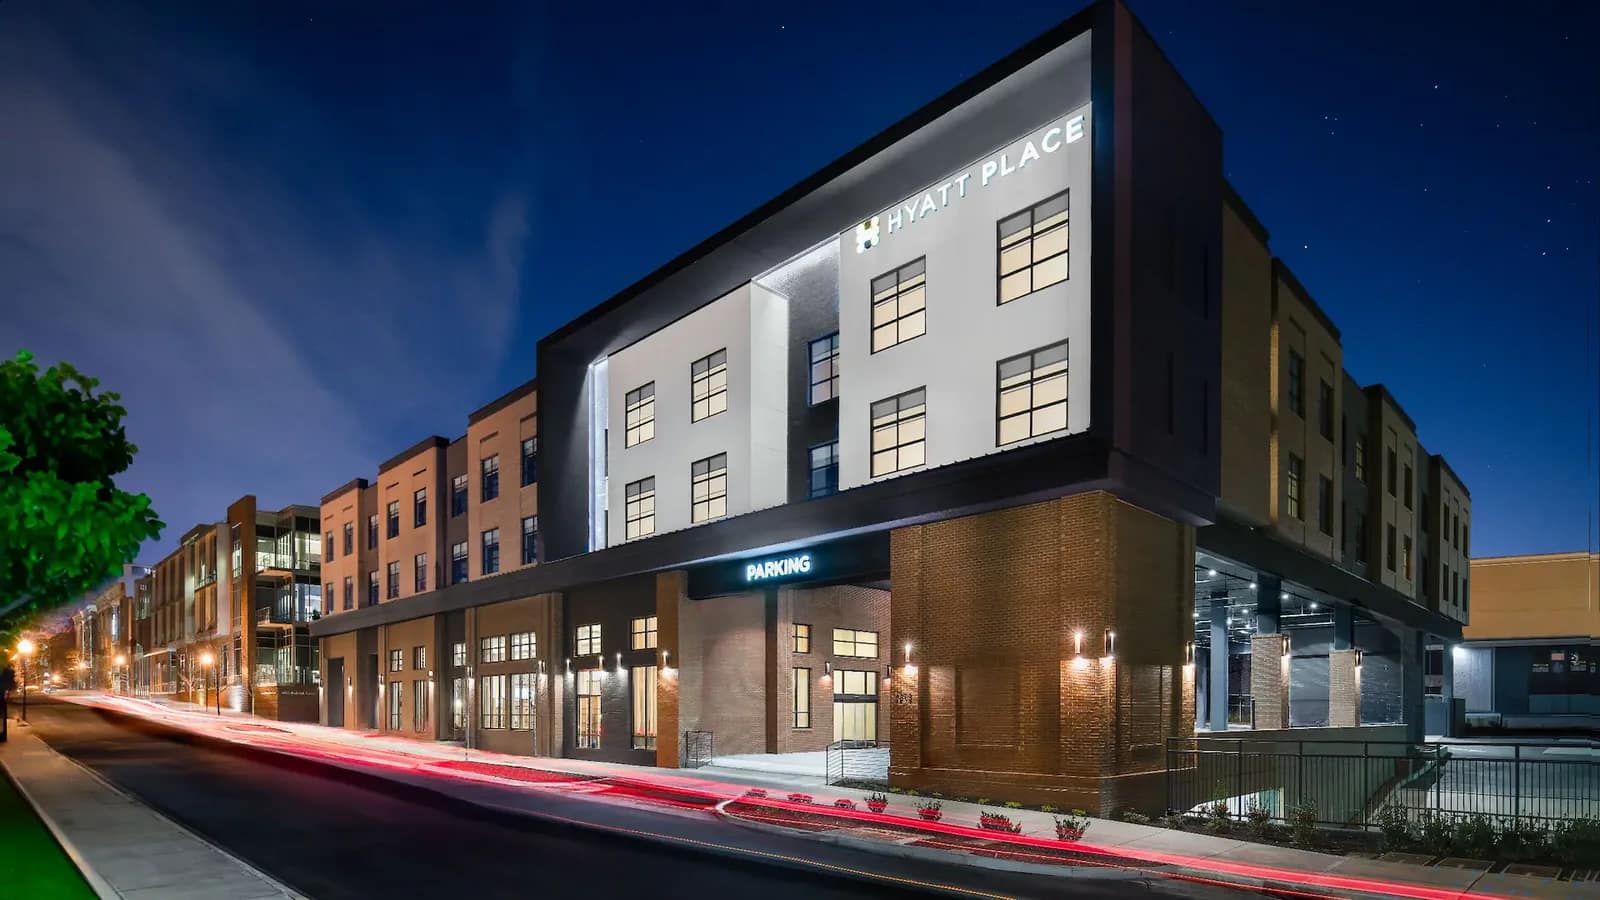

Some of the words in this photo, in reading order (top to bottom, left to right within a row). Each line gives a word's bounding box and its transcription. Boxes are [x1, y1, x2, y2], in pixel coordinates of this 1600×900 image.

[888, 173, 971, 234] HYATT
[982, 114, 1086, 187] PLACE
[746, 555, 811, 582] PARKING
